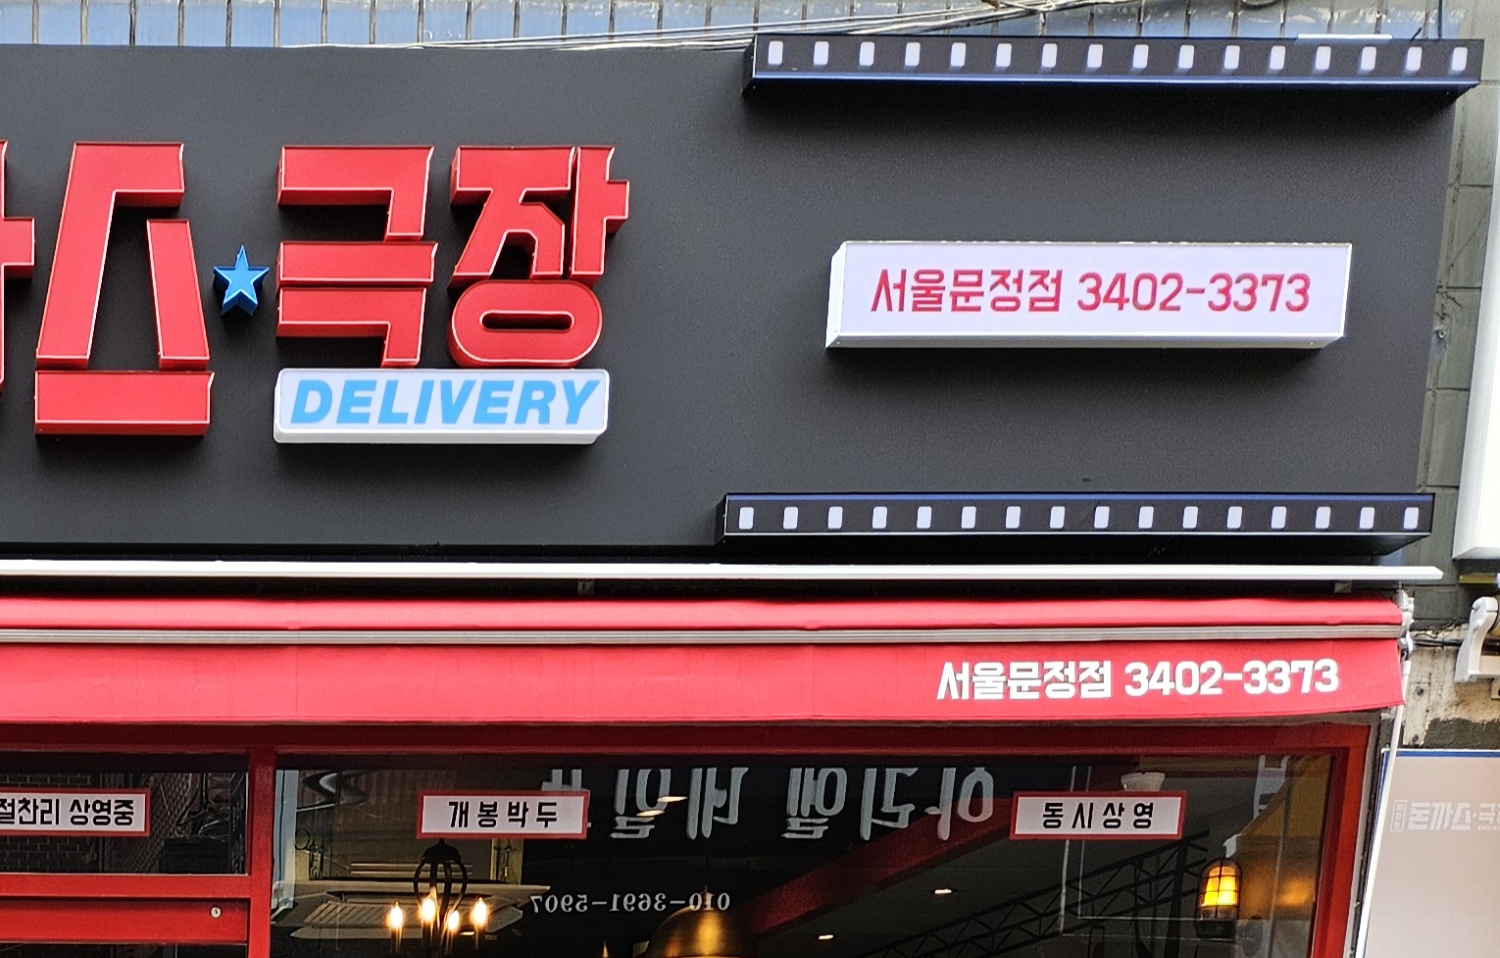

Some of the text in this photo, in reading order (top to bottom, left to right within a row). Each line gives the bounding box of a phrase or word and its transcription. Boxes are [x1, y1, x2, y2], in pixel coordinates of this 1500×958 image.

[275, 144, 630, 369] 극장
[870, 267, 1312, 313] 서울문정점 3402-3373
[289, 378, 601, 425] DELIVERY
[936, 658, 1341, 701] 서울문정점 3402-3373
[68, 798, 135, 827] 상영중
[447, 799, 559, 829] 개봉박두
[1040, 801, 1156, 831] 동시상영
[1407, 802, 1471, 831] 돈까스
[1477, 803, 1500, 825] 극
